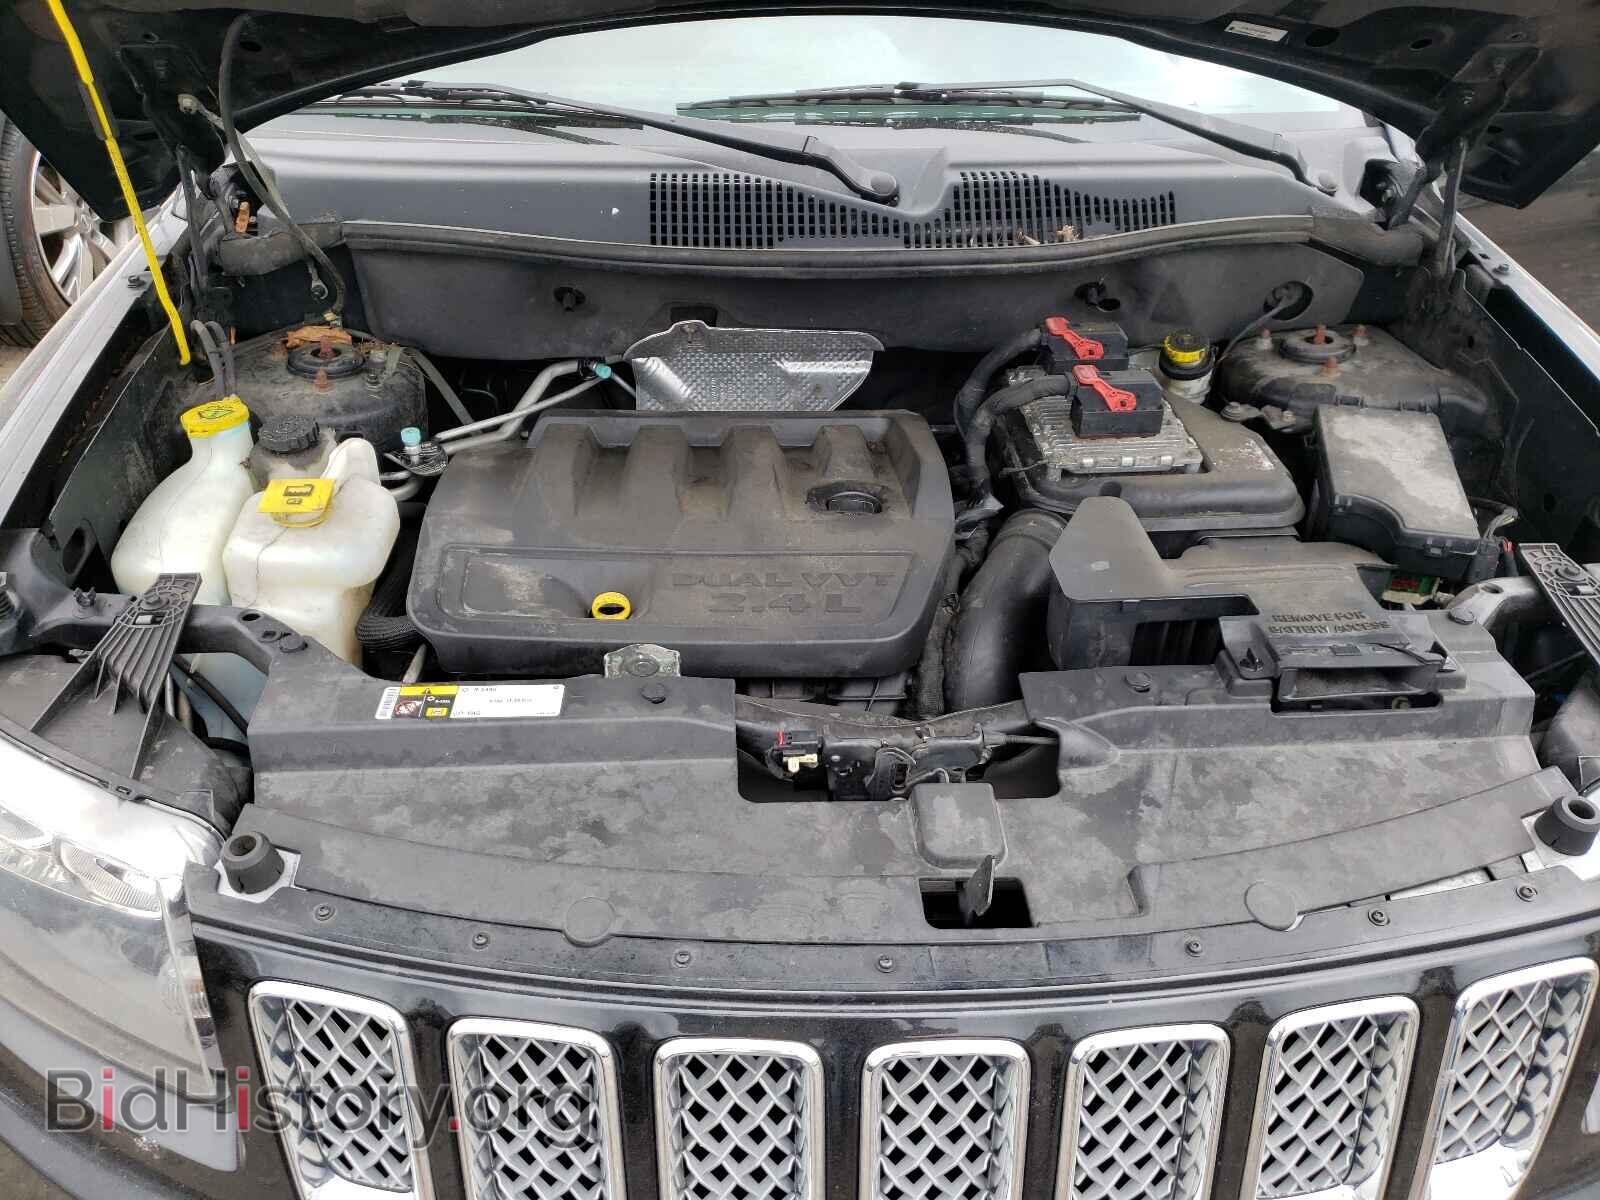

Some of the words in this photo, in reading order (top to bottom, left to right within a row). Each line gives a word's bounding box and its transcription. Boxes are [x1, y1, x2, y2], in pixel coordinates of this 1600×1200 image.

[671, 572, 794, 588] DUAL
[800, 572, 897, 588] VVT
[1271, 612, 1334, 623] REMOVE
[1335, 610, 1367, 622] FOR
[1268, 624, 1329, 634] BATTERY
[1333, 621, 1392, 633] ACCESS
